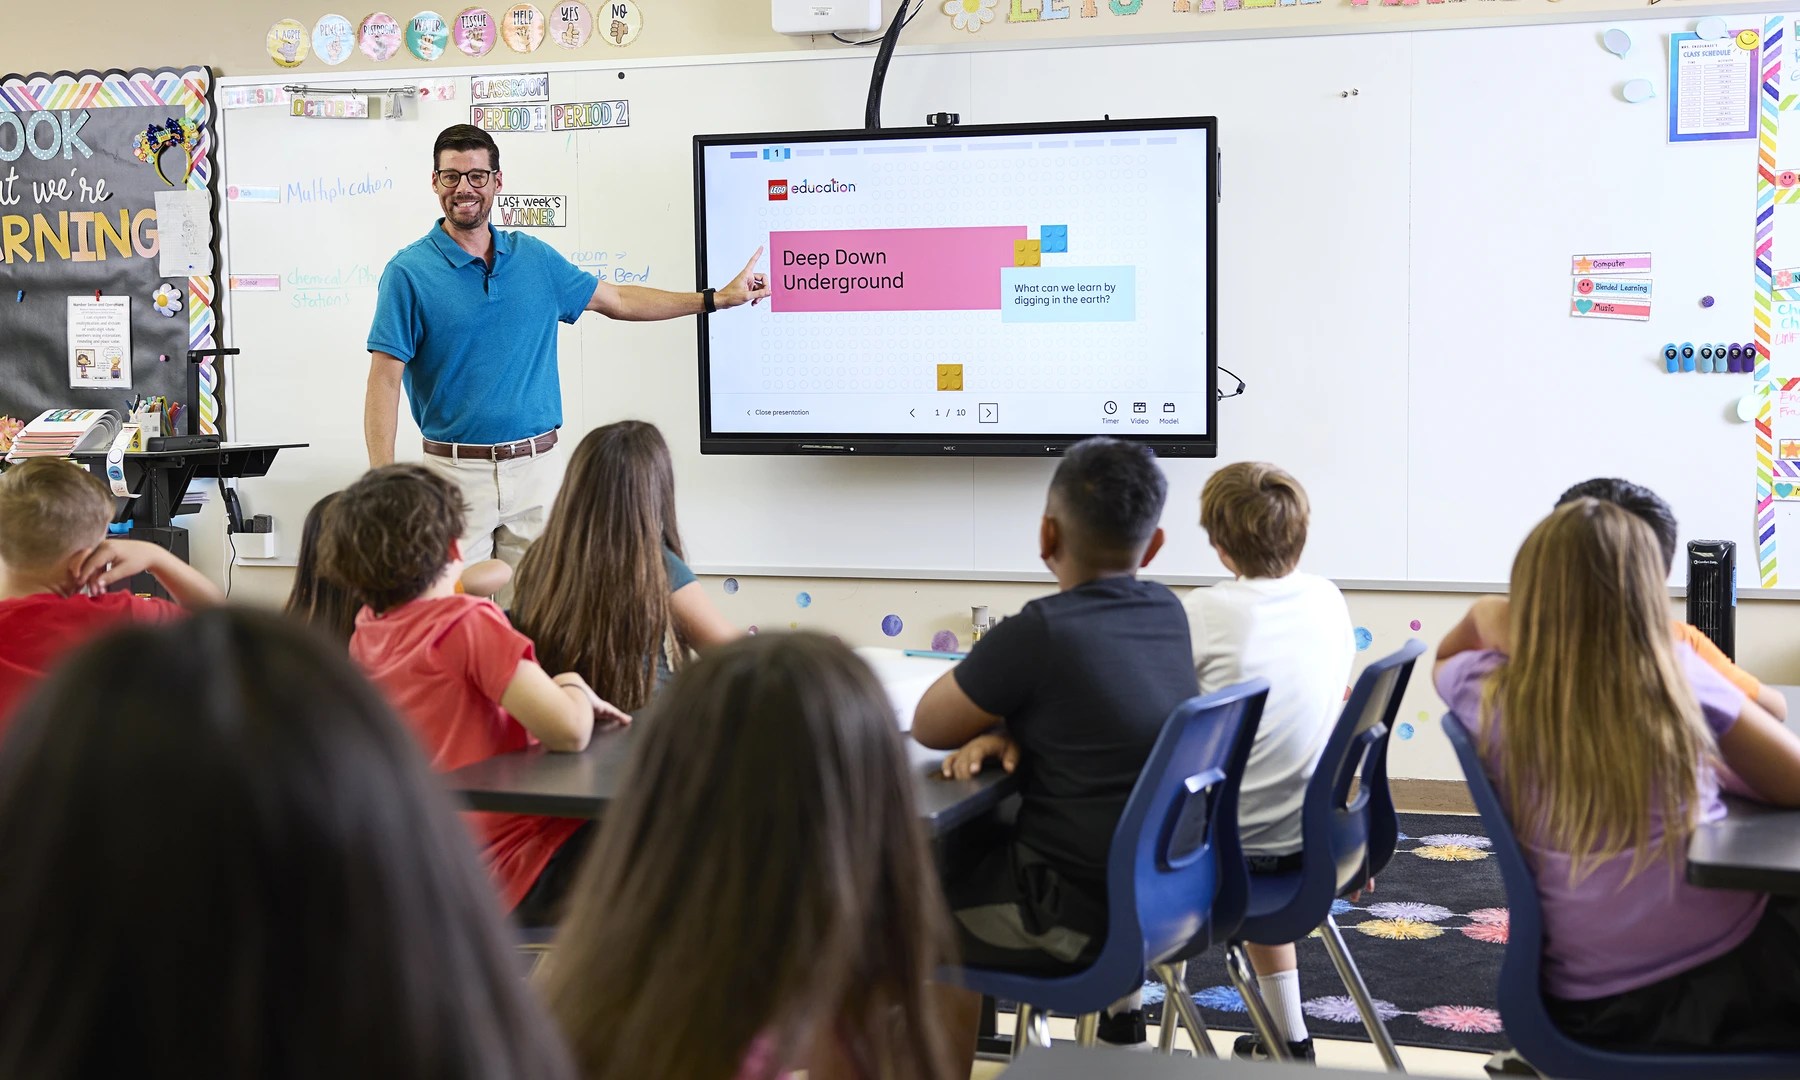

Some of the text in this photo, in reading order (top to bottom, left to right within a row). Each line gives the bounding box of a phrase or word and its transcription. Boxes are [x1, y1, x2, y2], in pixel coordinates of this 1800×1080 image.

[513, 10, 533, 25] HELP
[561, 6, 579, 22] YES
[611, 3, 628, 19] NO
[414, 19, 441, 32] WATER
[461, 14, 487, 28] TISSUE
[282, 29, 301, 40] AGREE
[319, 23, 346, 36] PENCIL
[363, 24, 396, 36] RESTROOM
[1702, 49, 1731, 57] SCHEDULE
[473, 77, 548, 99] CLASSROOM
[225, 87, 290, 106] TUESDA
[293, 98, 367, 117] OCTOBER
[554, 101, 627, 128] PERIOD 2
[473, 107, 543, 131] PERIOD 1
[774, 149, 779, 157] 1
[287, 171, 393, 204] Multiplication
[769, 178, 856, 194] LEGO education
[501, 208, 555, 226] WINNER
[0, 208, 159, 264] RNING
[783, 249, 886, 270] Deep Down
[1592, 259, 1626, 269] Computer
[614, 265, 650, 283] Bend
[783, 271, 904, 294] Underground
[1014, 284, 1039, 293] What
[1041, 285, 1059, 293] can
[1077, 283, 1102, 292] learn
[1104, 283, 1117, 293] by
[1595, 283, 1648, 293] Blended Learning
[290, 293, 350, 308] Stations
[1014, 294, 1111, 307] digging in the earth?
[1594, 303, 1615, 312] Music
[772, 409, 810, 417] presentation
[935, 409, 940, 417] 1
[956, 408, 966, 417] 10
[1101, 417, 1120, 425] Timer
[1130, 417, 1149, 425] Video
[1159, 417, 1179, 425] Model
